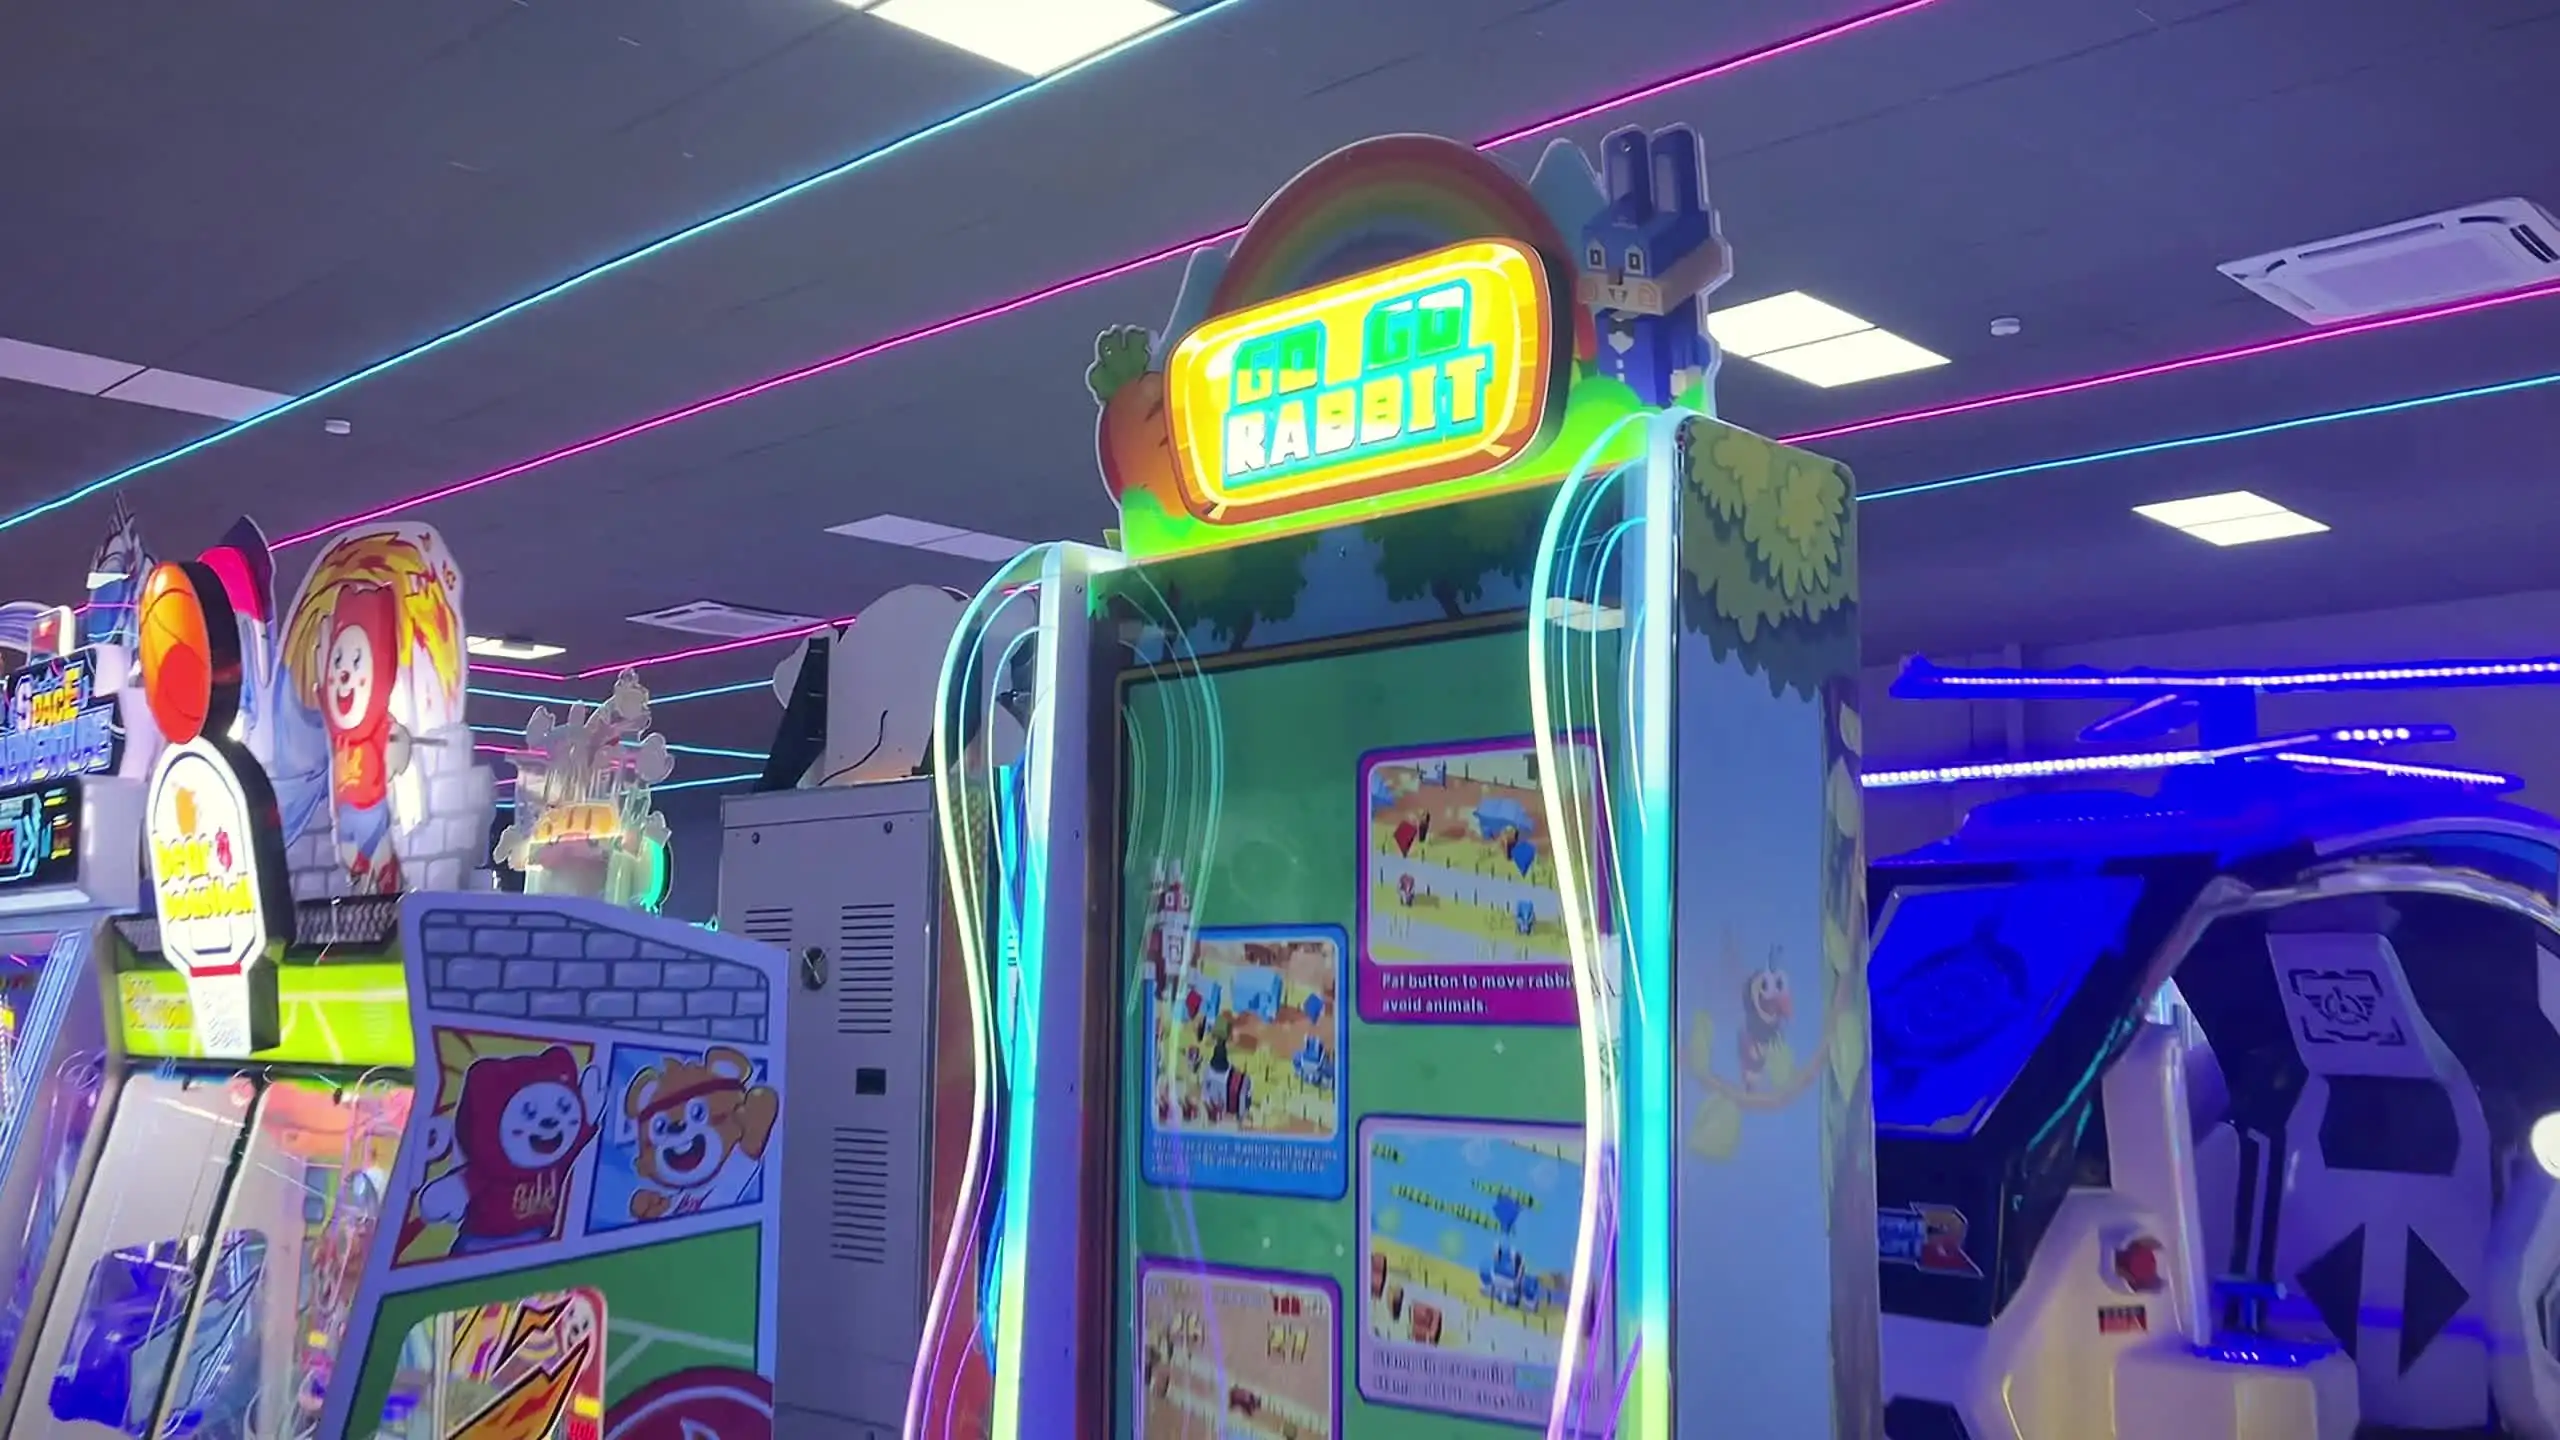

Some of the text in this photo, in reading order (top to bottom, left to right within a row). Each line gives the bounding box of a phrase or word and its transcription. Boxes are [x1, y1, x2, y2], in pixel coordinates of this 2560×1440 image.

[1233, 280, 1469, 404] GO GO
[1225, 347, 1489, 480] RABBIT
[1382, 996, 1488, 1014] avoid animals.
[1408, 972, 1459, 990] button
[1462, 973, 1478, 989] to
[1482, 974, 1524, 989] move
